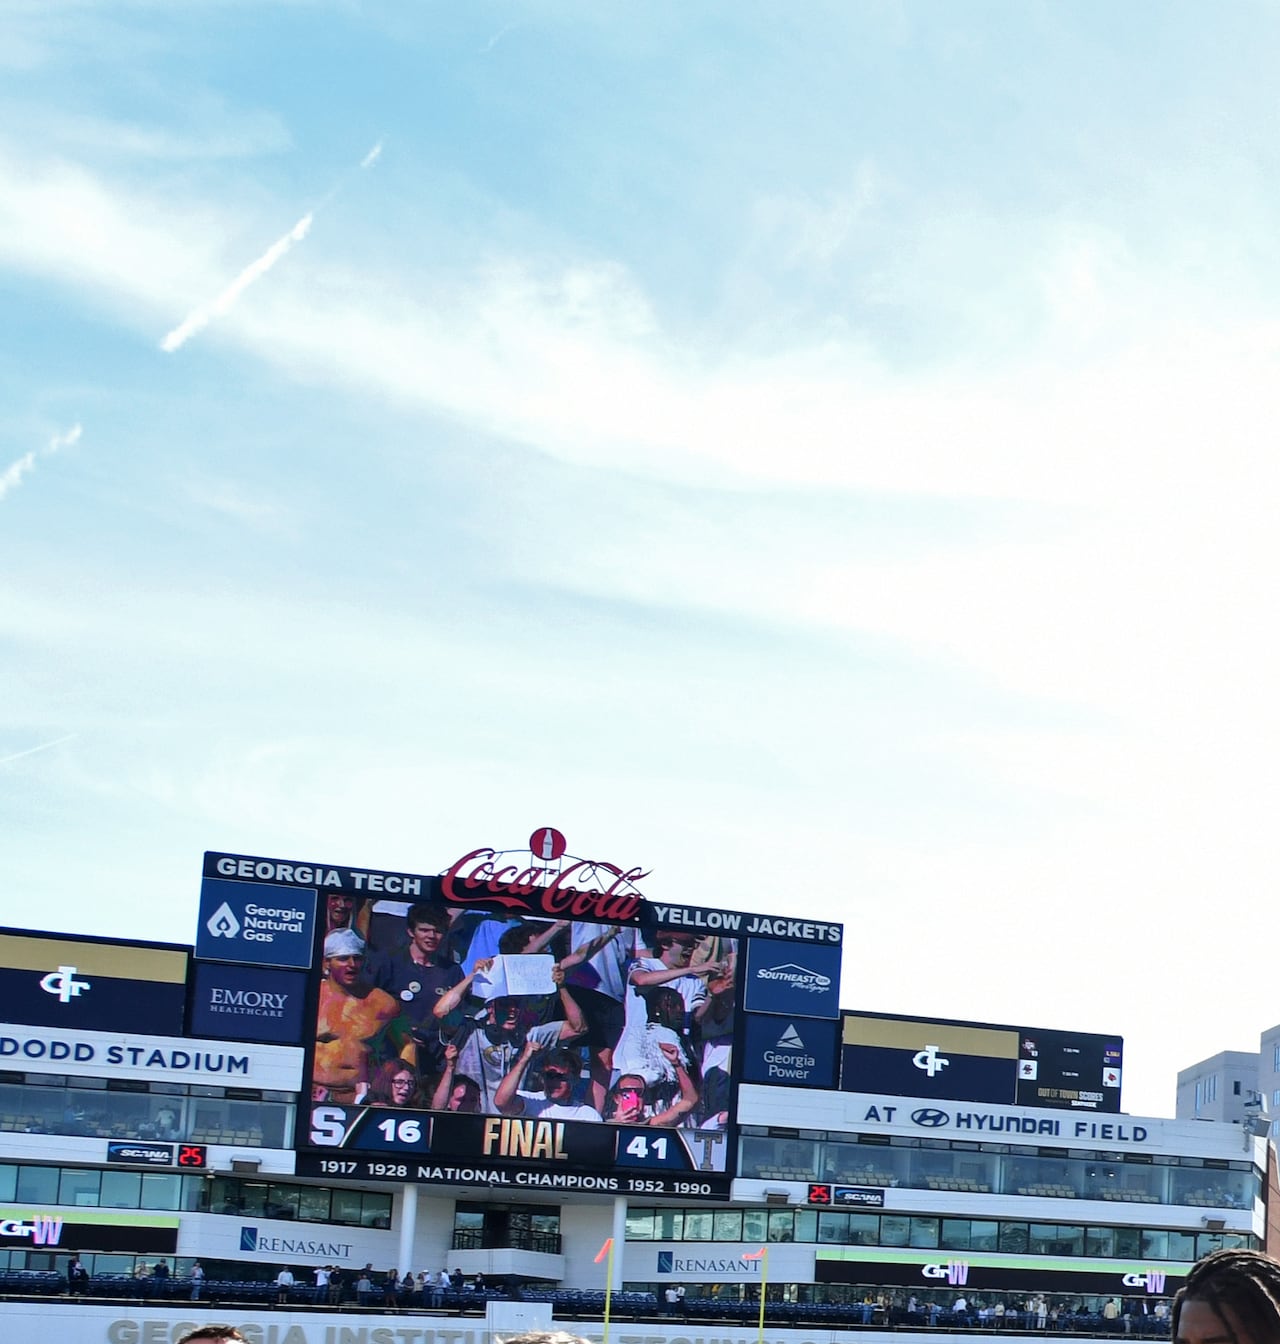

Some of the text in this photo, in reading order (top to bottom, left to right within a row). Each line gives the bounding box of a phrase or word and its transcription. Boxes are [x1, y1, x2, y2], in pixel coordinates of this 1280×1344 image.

[216, 857, 422, 896] GEORGIA TECH
[440, 847, 655, 921] Coca-Cola
[244, 903, 306, 922] Georgia
[243, 916, 303, 934] Natural
[653, 905, 842, 943] YELLOW JACKETS
[242, 929, 275, 944] Gas
[757, 969, 816, 985] SOUTHEAST
[211, 988, 288, 1009] EMORY
[210, 1005, 284, 1018] HEALTHCARE
[0, 1036, 249, 1075] DODD STADIUM
[763, 1050, 816, 1068] Georgia
[768, 1065, 810, 1079] Power
[378, 1118, 421, 1144] 16
[864, 1105, 1148, 1143] AT HYUNDAI FIELD
[483, 1118, 569, 1160] FINAL
[626, 1135, 668, 1160] 41
[119, 1149, 171, 1160] SCANA
[320, 1160, 711, 1195] 1917 1928 NATIONAL CHAMPIONS 1952 1990
[844, 1192, 882, 1202] SCANA
[258, 1236, 353, 1258] RENASANT
[674, 1258, 762, 1273] RENASANT
